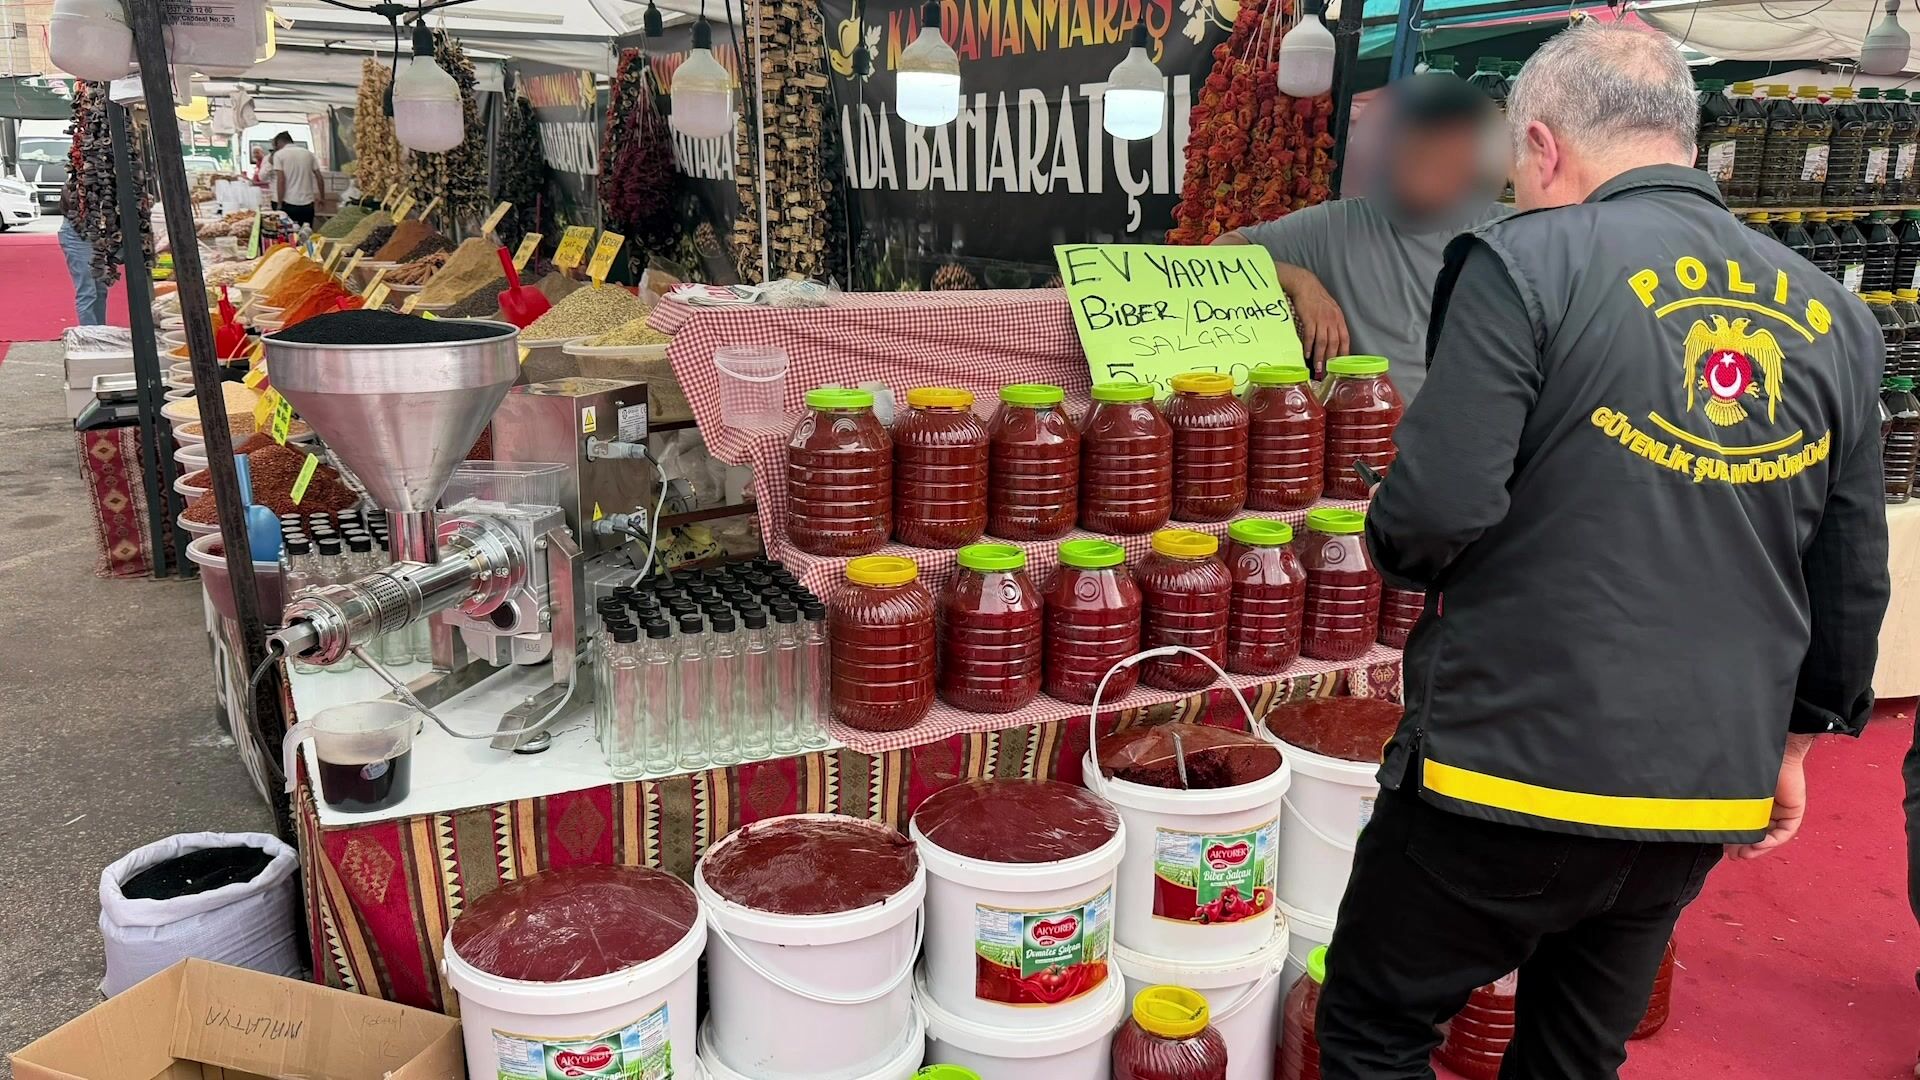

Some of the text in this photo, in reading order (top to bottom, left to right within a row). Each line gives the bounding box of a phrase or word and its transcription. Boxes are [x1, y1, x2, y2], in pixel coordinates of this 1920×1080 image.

[887, 0, 1173, 71] KARAMANMARAŞ
[842, 101, 899, 190] ADA
[1064, 247, 1269, 290] EV YAPIMI
[1591, 406, 1696, 475] GÜVENLİK
[1730, 428, 1831, 485] MÜDÜRLÜĞ
[1203, 870, 1226, 881] Biber
[1025, 947, 1056, 960] Domates
